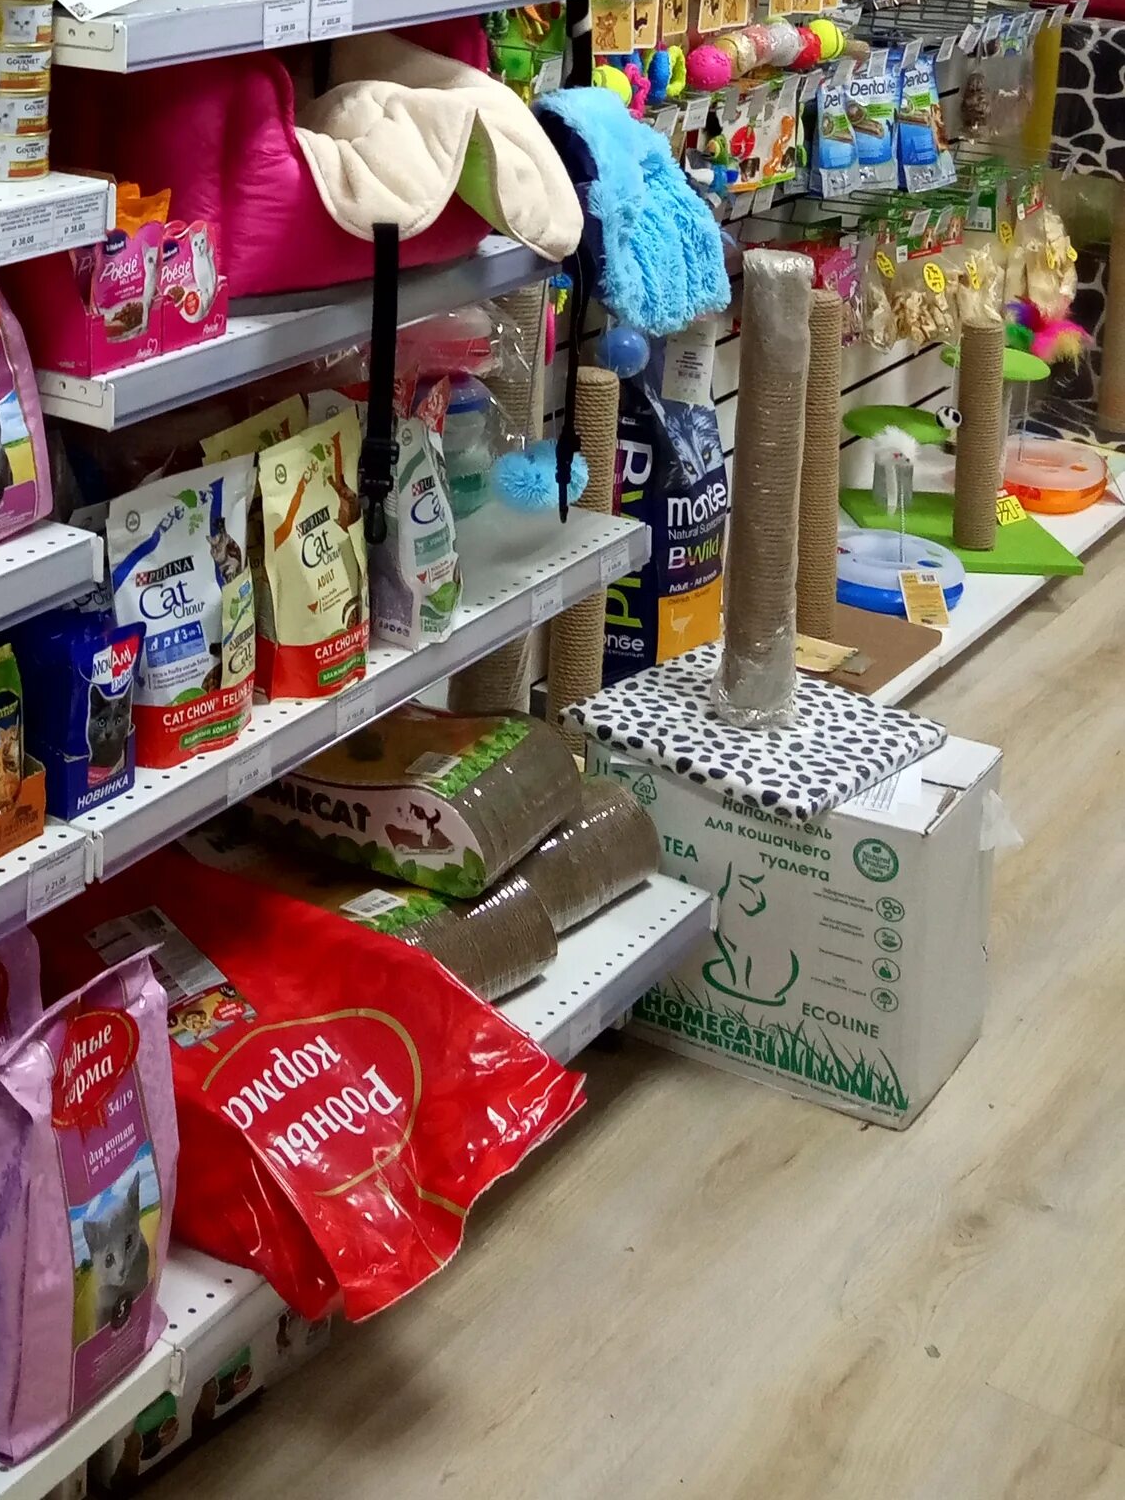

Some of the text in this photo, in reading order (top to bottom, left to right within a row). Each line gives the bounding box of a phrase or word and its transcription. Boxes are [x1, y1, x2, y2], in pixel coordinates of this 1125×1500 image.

[6, 57, 40, 65] GOURMET
[303, 506, 330, 535] PURINA
[668, 525, 699, 542] Natural
[302, 529, 333, 568] Cat
[148, 563, 194, 583] PURINA
[317, 569, 335, 591] ADULT
[669, 580, 688, 593] Adult
[139, 577, 194, 620] Cat
[315, 645, 334, 660] CAT
[163, 711, 185, 727] CAT
[76, 773, 130, 810] НОВИНКА
[273, 779, 372, 833] MECAT
[663, 835, 699, 863] TEA
[704, 816, 832, 861] для кошачьего
[758, 852, 830, 882] туалета
[861, 857, 891, 872] Product
[862, 850, 891, 866] Natural
[52, 876, 67, 889] 21,00
[644, 994, 769, 1050] HOMECAT
[801, 1002, 880, 1040] ECOLINE
[220, 1034, 342, 1131] корма
[107, 1089, 134, 1117] 34/19
[88, 1122, 135, 1166] для котят
